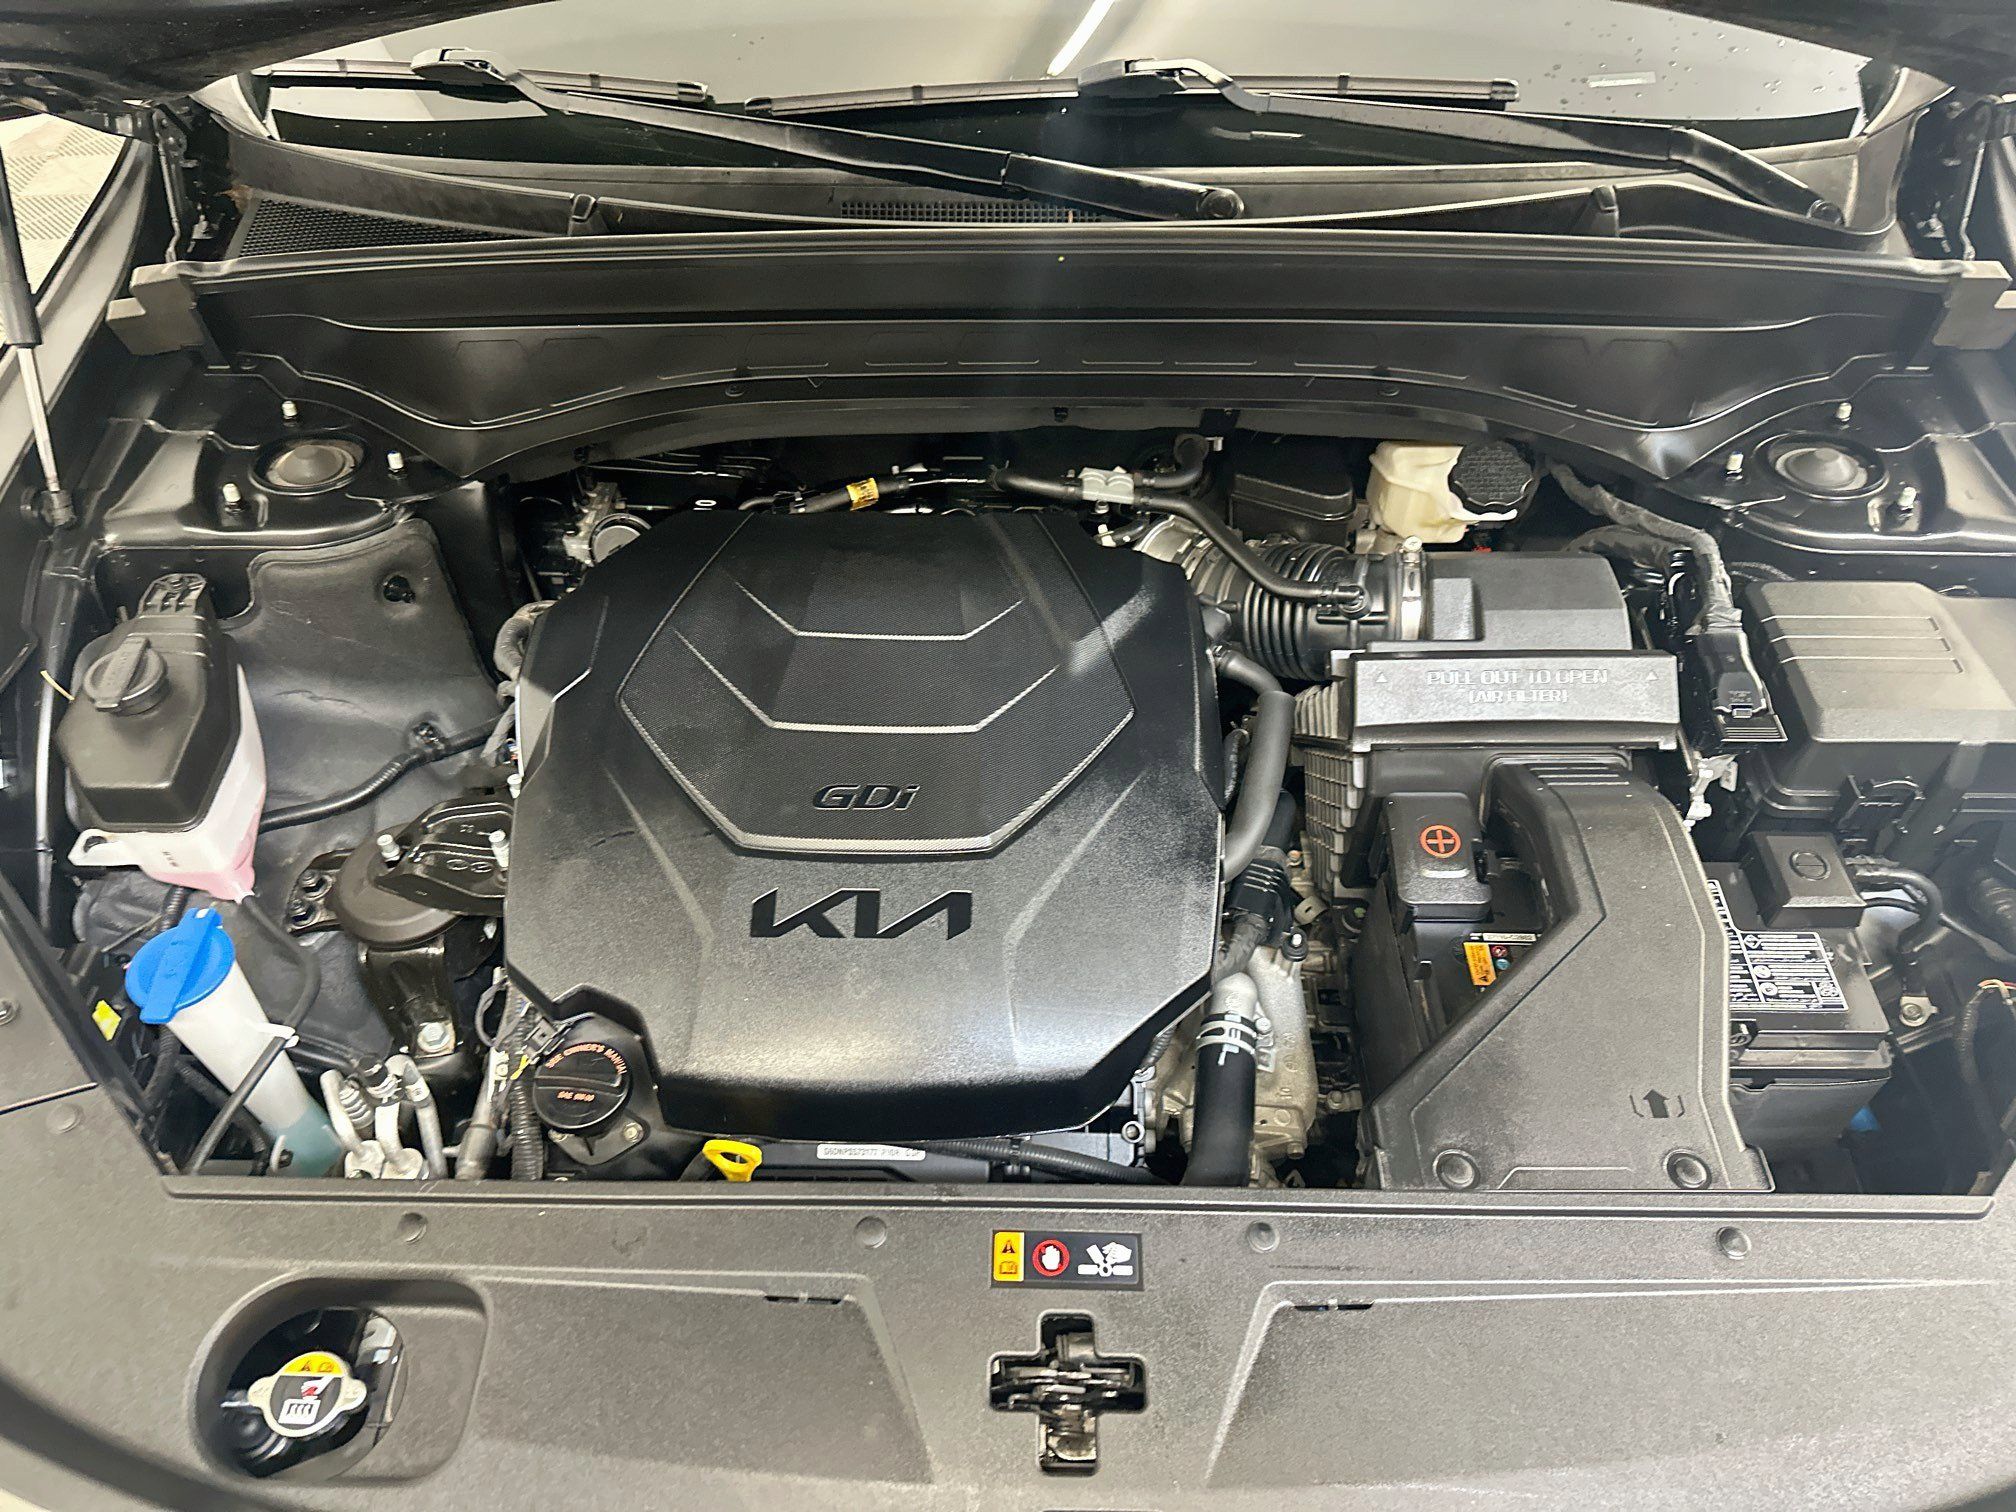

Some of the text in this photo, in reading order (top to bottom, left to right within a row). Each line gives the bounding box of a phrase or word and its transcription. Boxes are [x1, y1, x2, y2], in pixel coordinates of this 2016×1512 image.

[1426, 668, 1608, 686] PULL OUT TO OPEN
[750, 886, 973, 940] KIA
